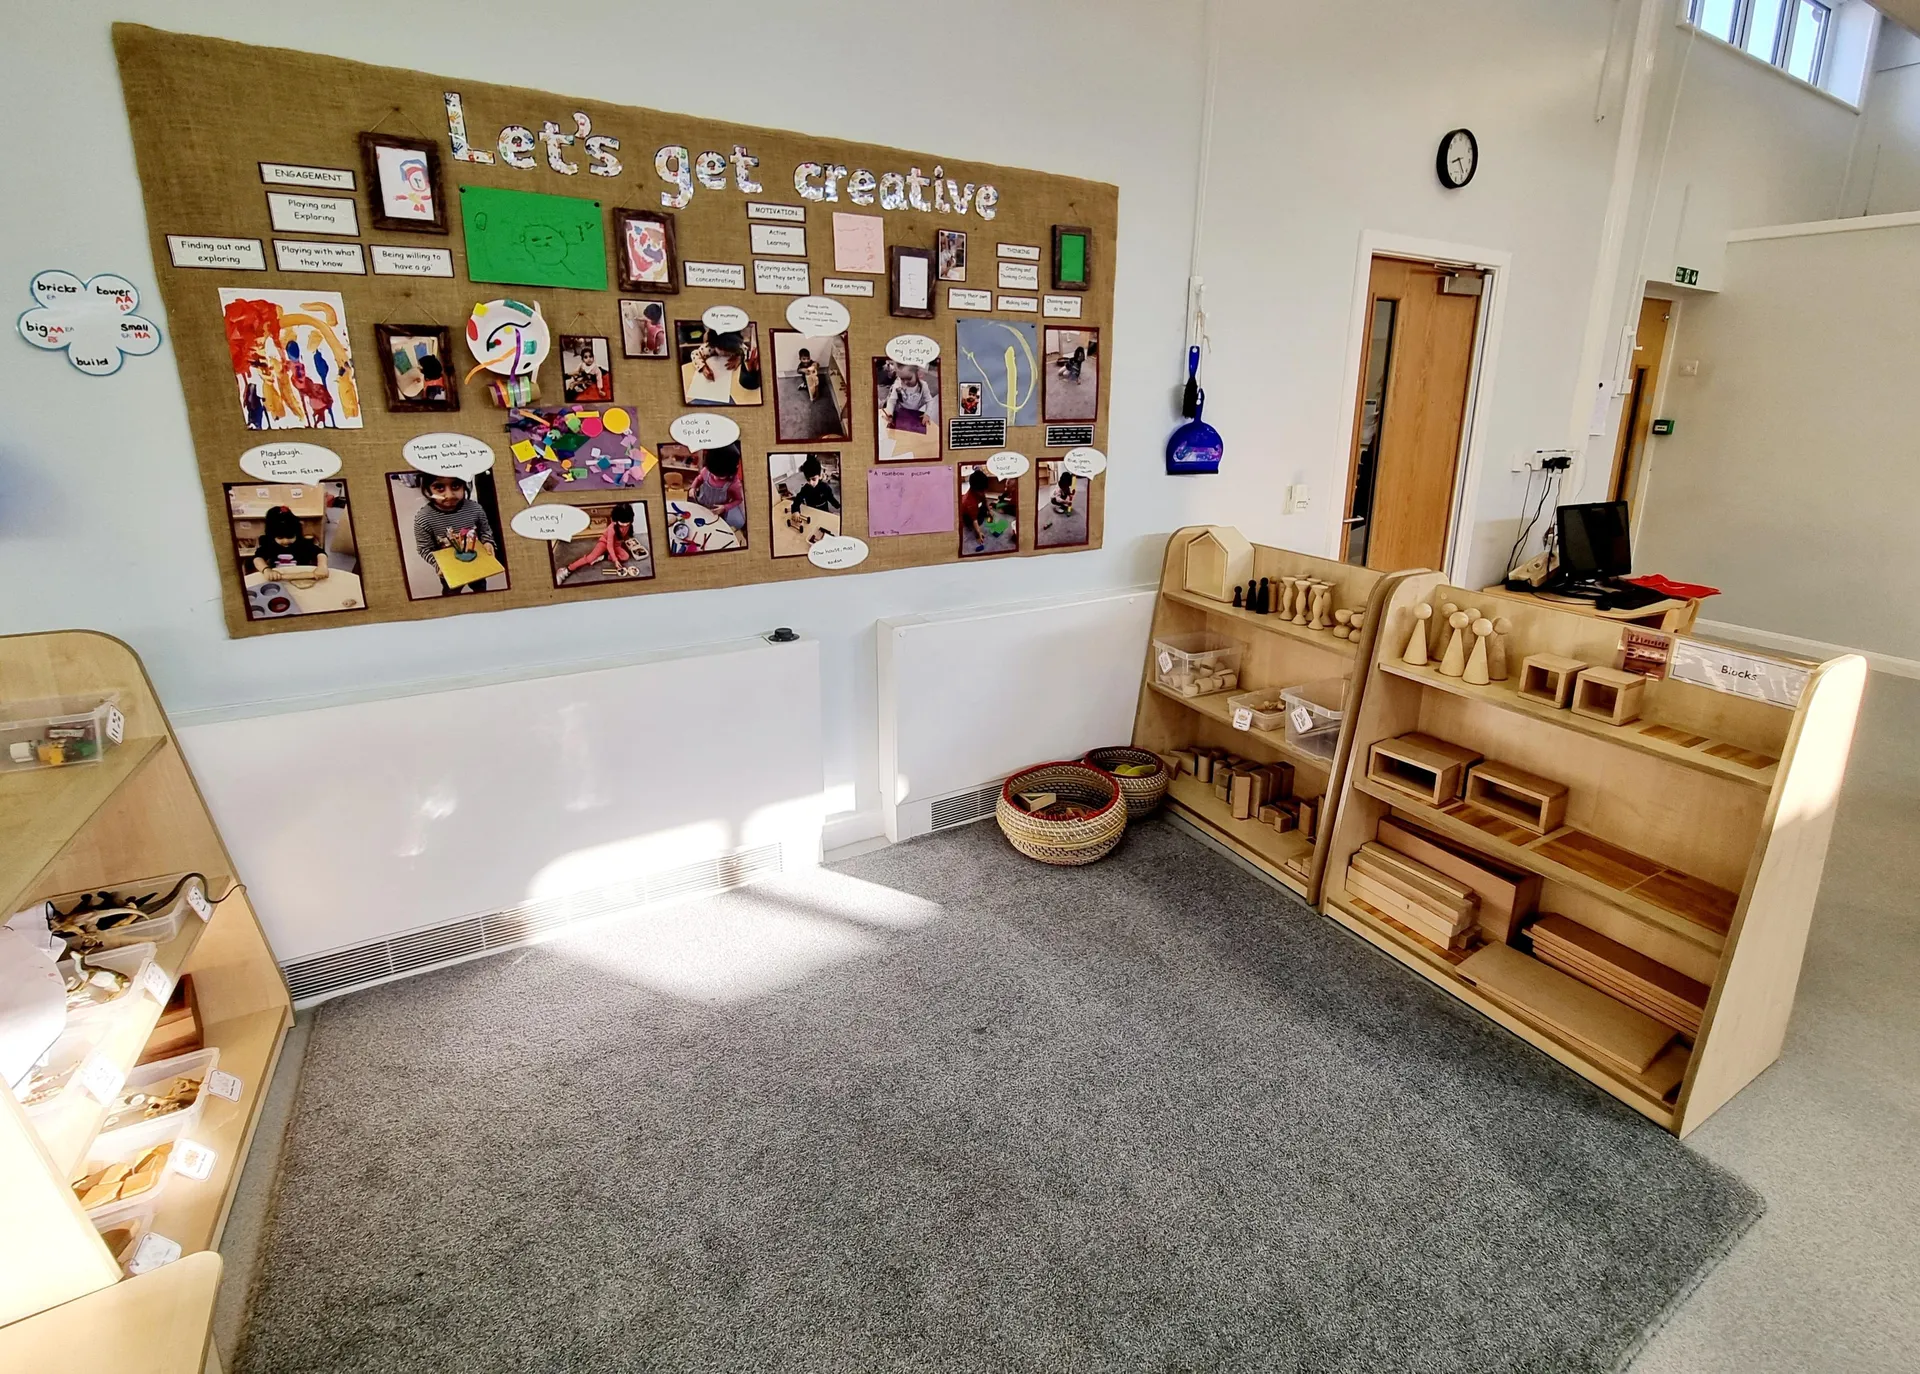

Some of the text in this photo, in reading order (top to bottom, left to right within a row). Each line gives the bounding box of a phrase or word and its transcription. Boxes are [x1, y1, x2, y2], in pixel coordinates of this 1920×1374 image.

[444, 92, 999, 220] Let's get creative
[275, 169, 342, 181] ENGAGEMENT
[288, 199, 318, 210] Playing
[294, 211, 335, 223] Exploring
[755, 207, 798, 216] MOTIVATION
[181, 241, 214, 251] Finding
[766, 239, 791, 248] Learning
[281, 245, 312, 256] Playing
[382, 250, 404, 260] Being
[406, 252, 430, 261] willing
[198, 255, 240, 265] exploring
[300, 259, 319, 268] they
[688, 266, 705, 274] Being
[757, 264, 806, 274] Enjoying achieving
[695, 277, 736, 285] concentrating
[37, 281, 77, 293] bricks
[96, 286, 130, 297] tower
[26, 321, 48, 338] big
[76, 357, 109, 367] build
[530, 513, 564, 524] Monkey!
[1721, 664, 1758, 681] Blocks
